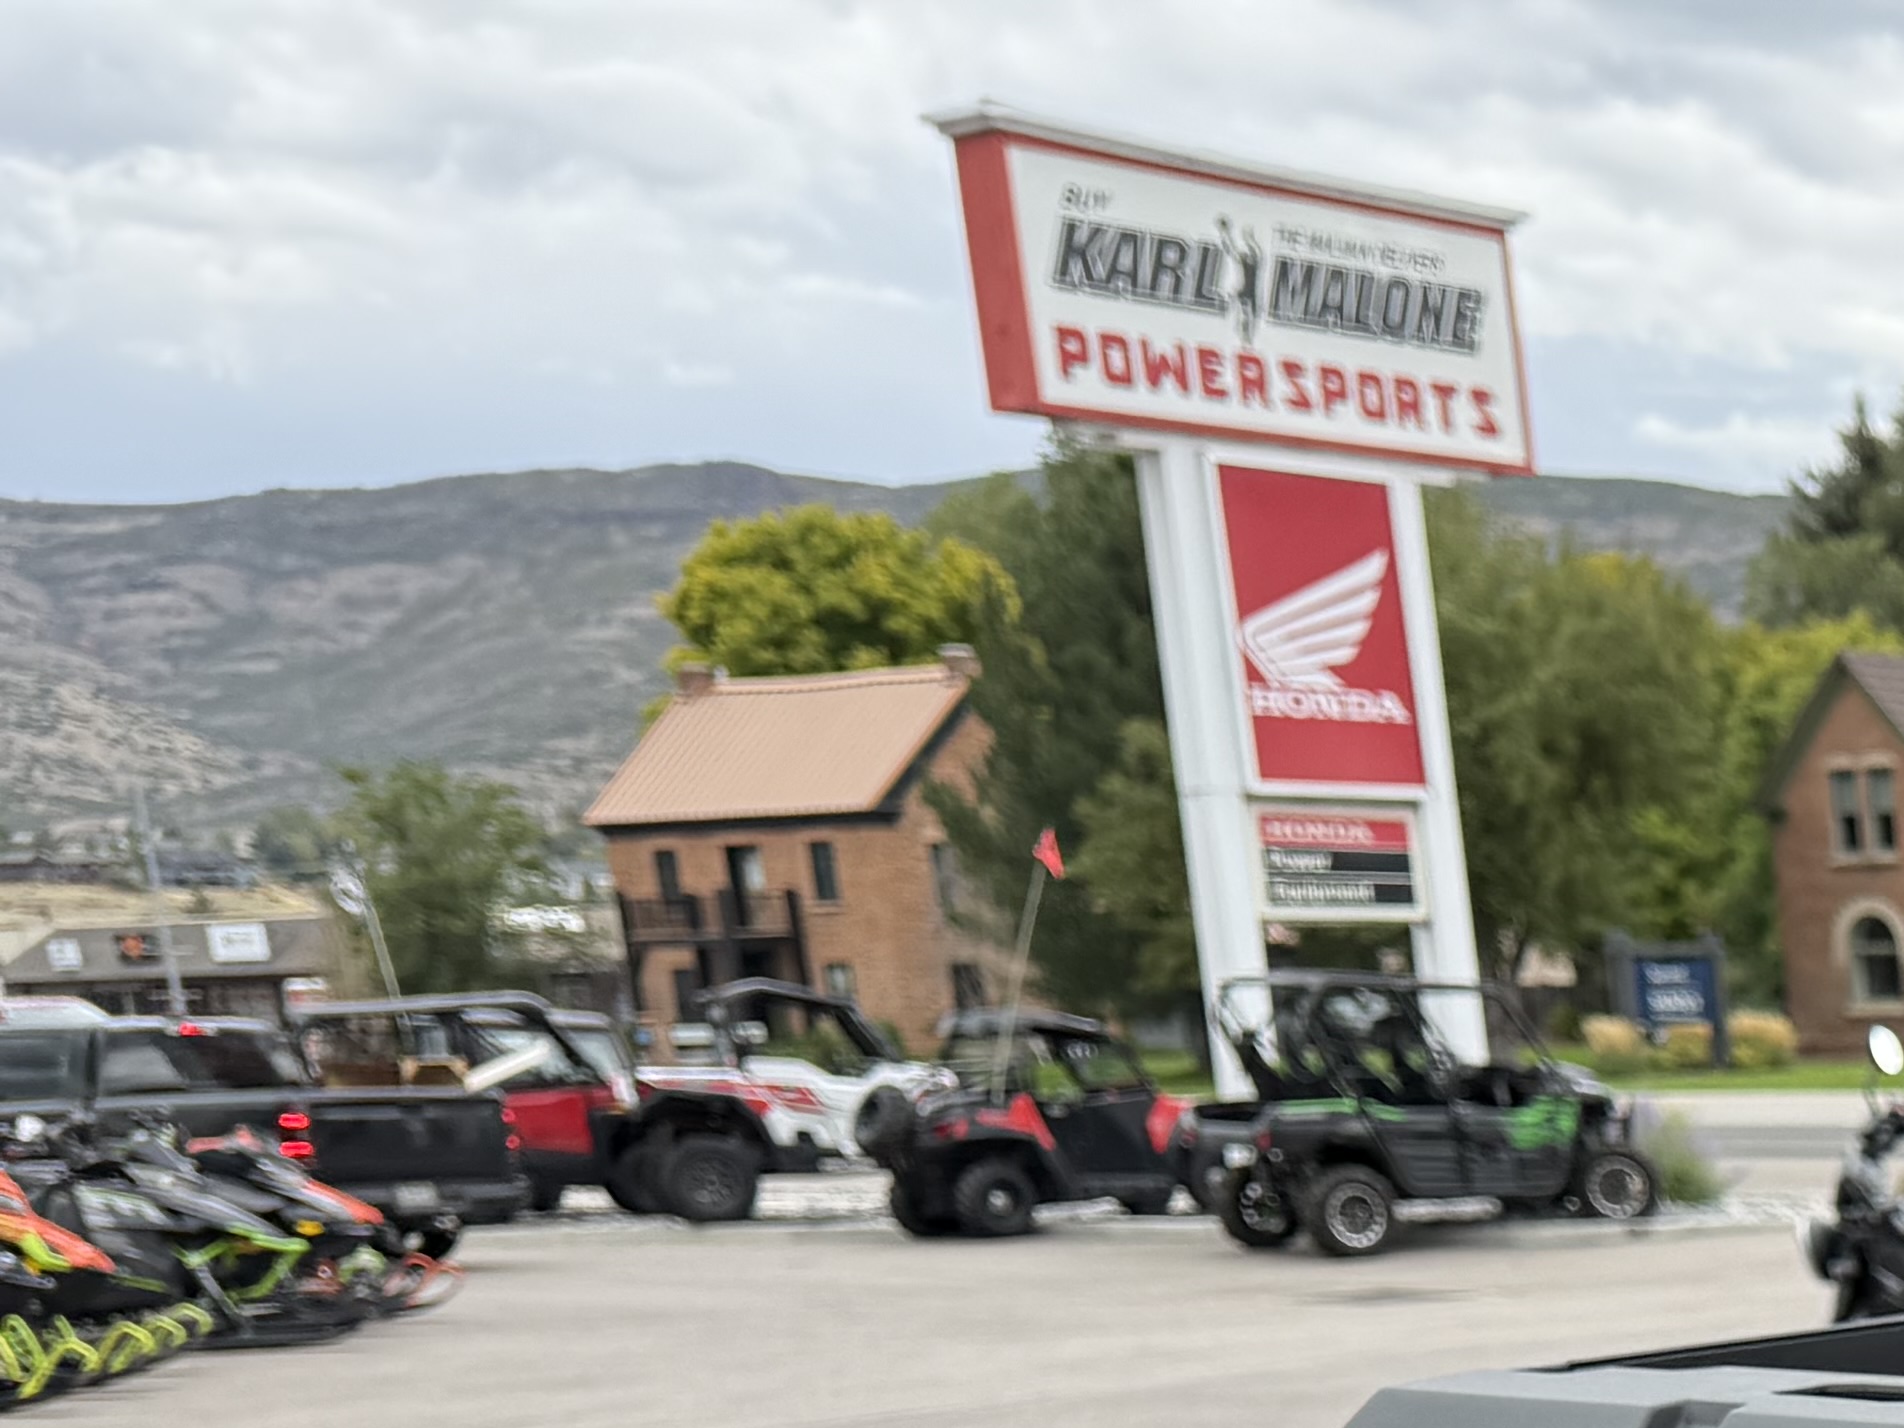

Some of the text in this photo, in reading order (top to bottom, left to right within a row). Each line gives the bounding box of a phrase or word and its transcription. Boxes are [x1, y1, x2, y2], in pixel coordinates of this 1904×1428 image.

[1052, 215, 1483, 355] KARL MALONE
[1055, 325, 1498, 435] POWERSPORTS
[1250, 686, 1412, 725] HONDA
